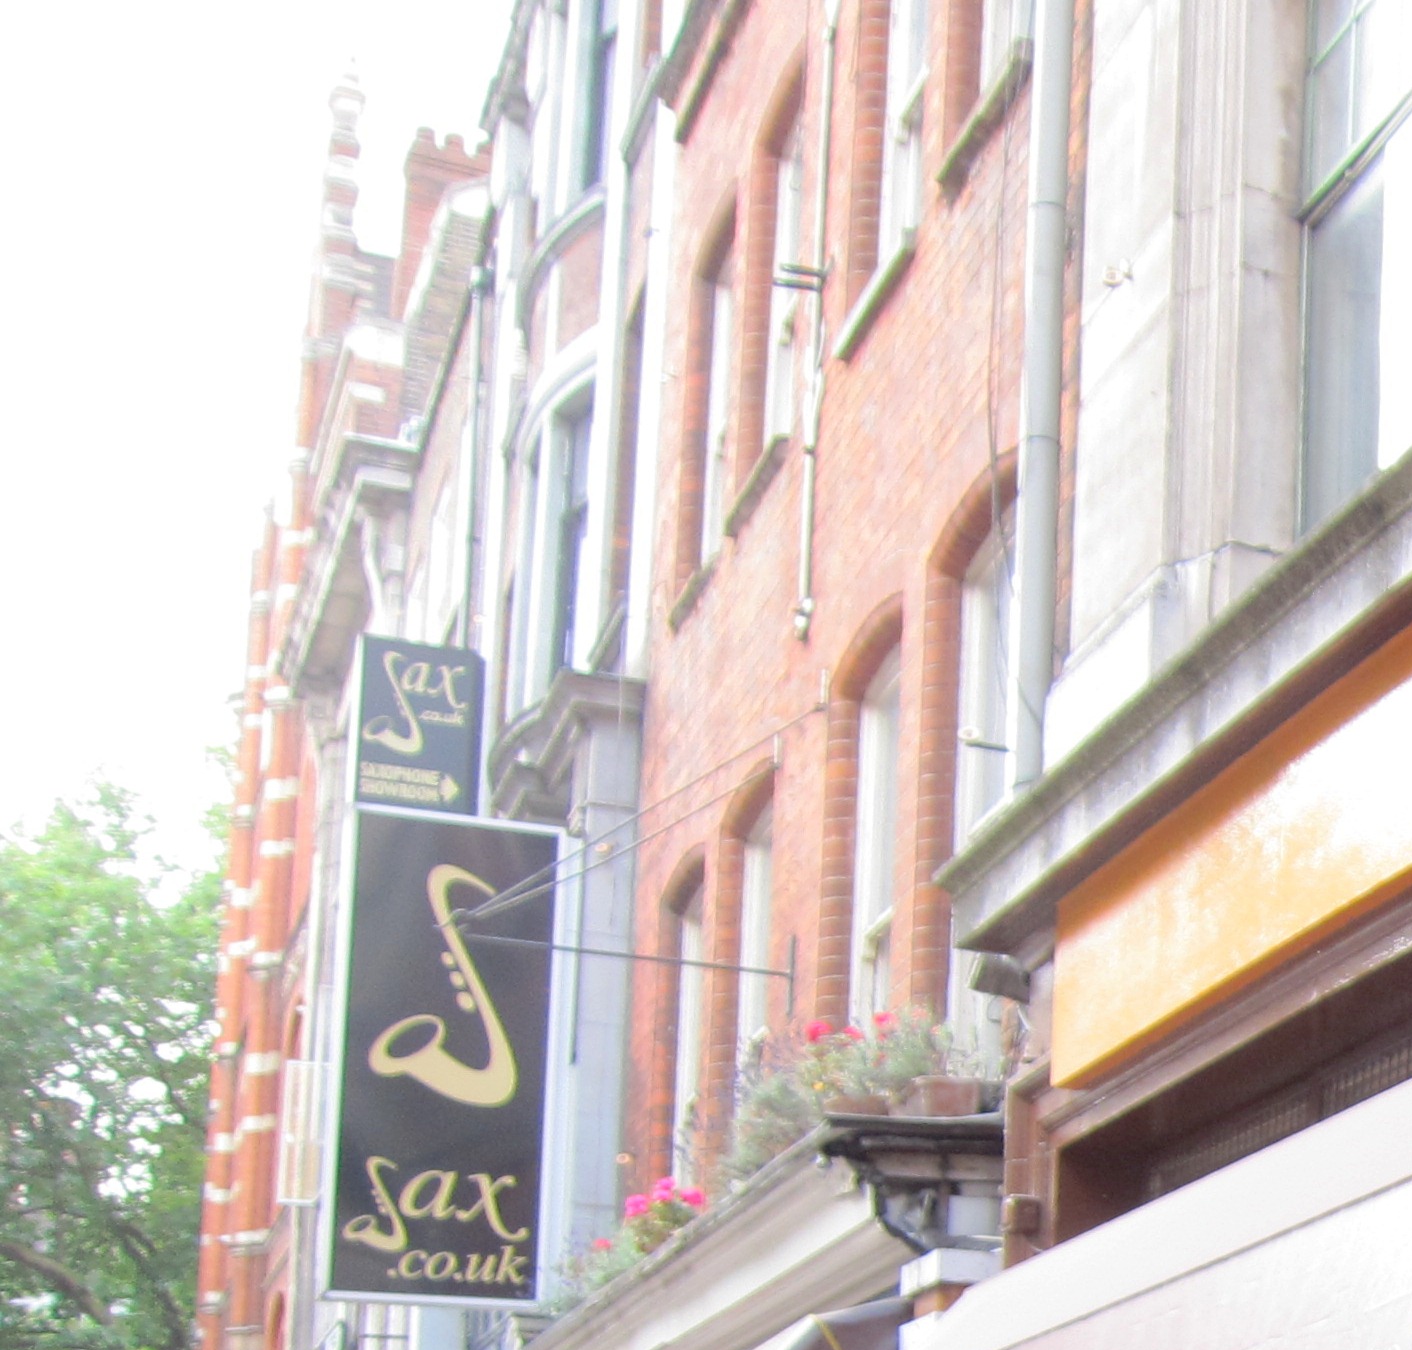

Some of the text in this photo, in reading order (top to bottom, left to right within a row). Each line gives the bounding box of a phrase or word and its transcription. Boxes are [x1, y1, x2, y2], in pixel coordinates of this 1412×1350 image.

[362, 651, 468, 756] Sax
[342, 1155, 530, 1251] Sax
[386, 1245, 530, 1285] .co.uk
